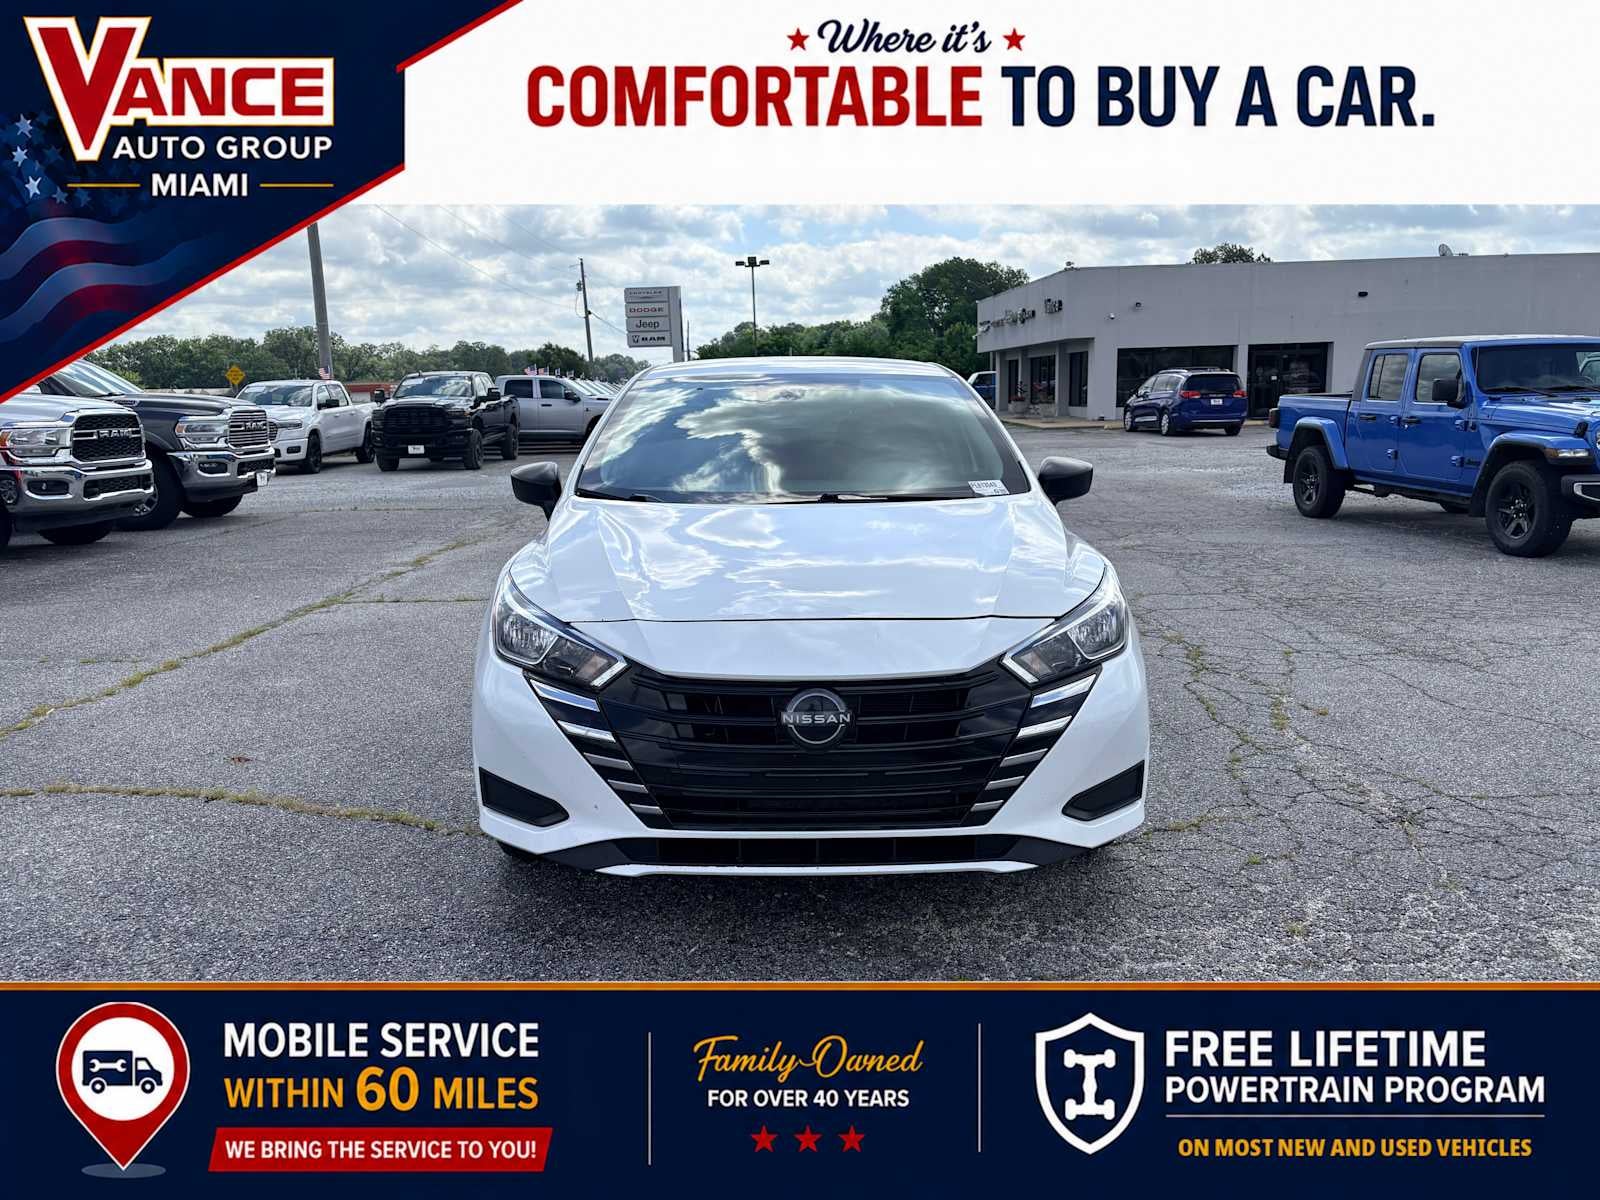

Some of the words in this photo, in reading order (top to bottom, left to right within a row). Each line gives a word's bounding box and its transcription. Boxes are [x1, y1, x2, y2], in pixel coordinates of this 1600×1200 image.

[635, 320, 660, 329] Jeep
[98, 428, 132, 438] RAM
[782, 713, 851, 724] NISSAN
